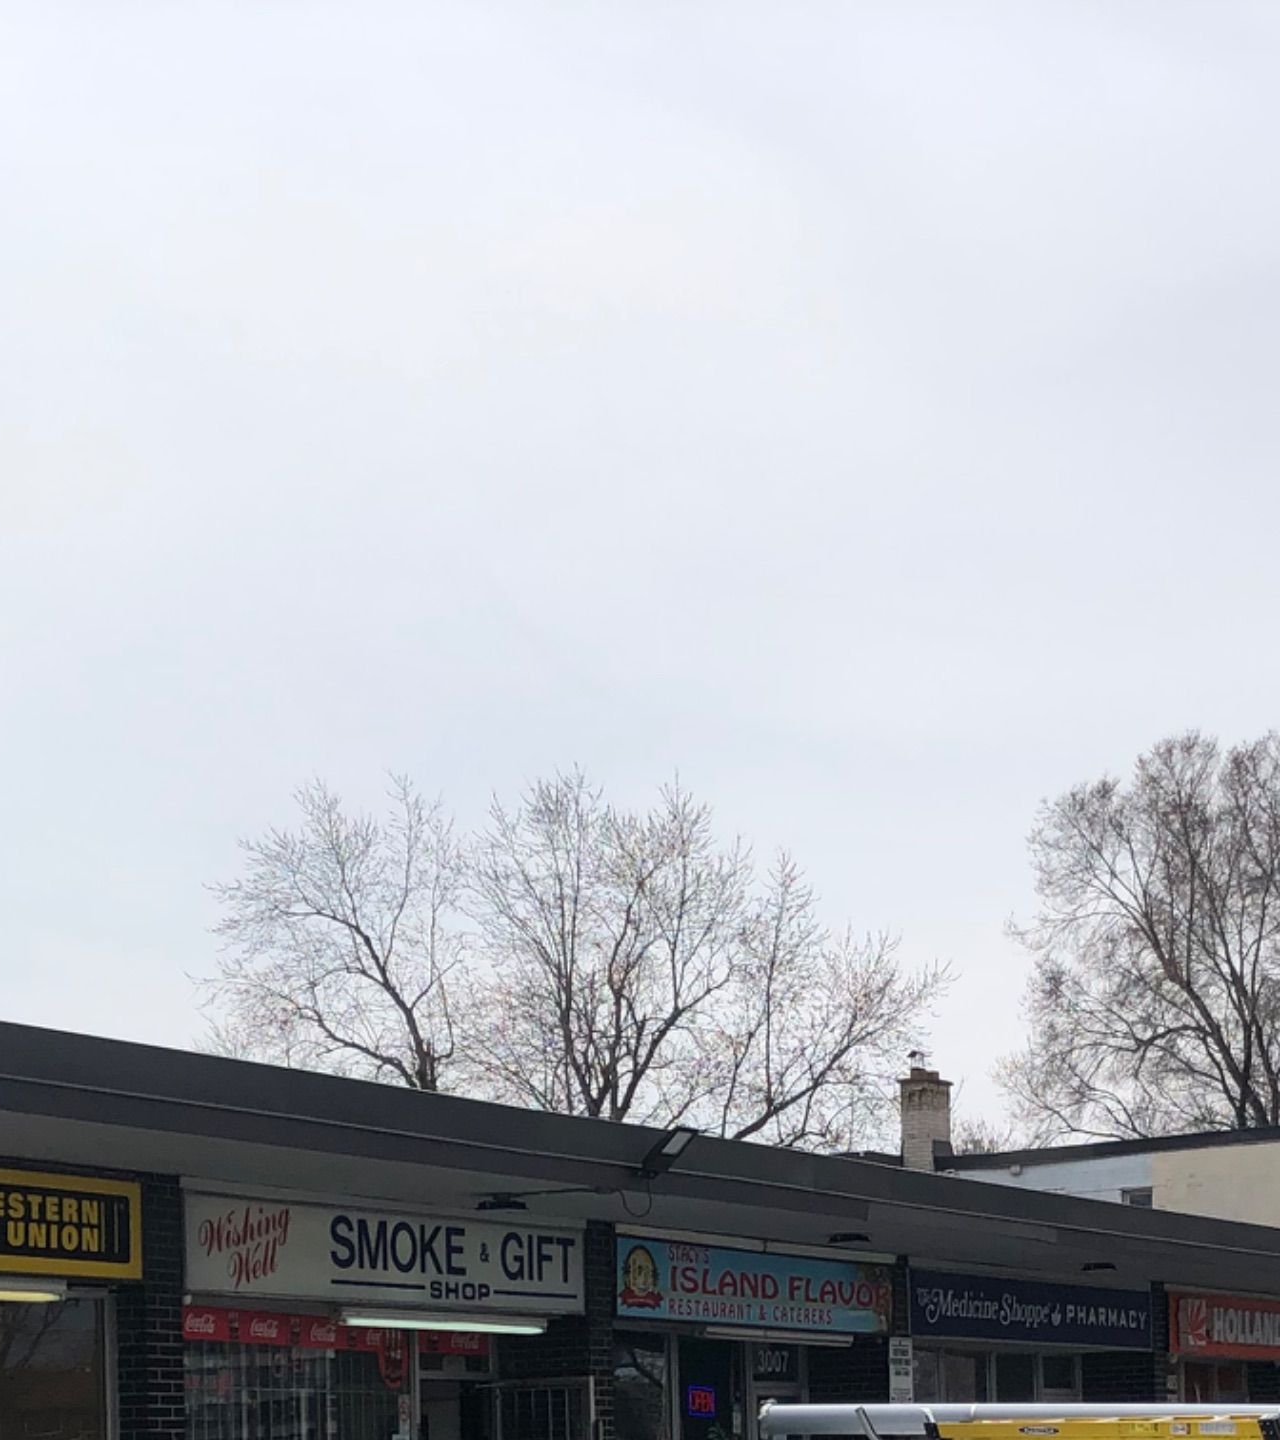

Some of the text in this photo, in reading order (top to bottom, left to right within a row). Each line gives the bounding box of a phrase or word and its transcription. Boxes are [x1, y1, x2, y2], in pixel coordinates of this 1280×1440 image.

[7, 1221, 99, 1252] UNION
[199, 1207, 290, 1257] Wishing
[330, 1214, 576, 1284] SMOKE & GIFT
[227, 1236, 278, 1290] Well
[668, 1244, 710, 1265] STACY'S
[429, 1281, 490, 1301] SHOP
[670, 1265, 891, 1308] ISLAND FLAVOR
[668, 1298, 832, 1326] RESTAURANT & CATERERS
[926, 1288, 999, 1323] Medicine
[999, 1293, 1050, 1328] Shoppe
[1066, 1305, 1147, 1330] PHARMACY
[758, 1350, 789, 1373] 3007
